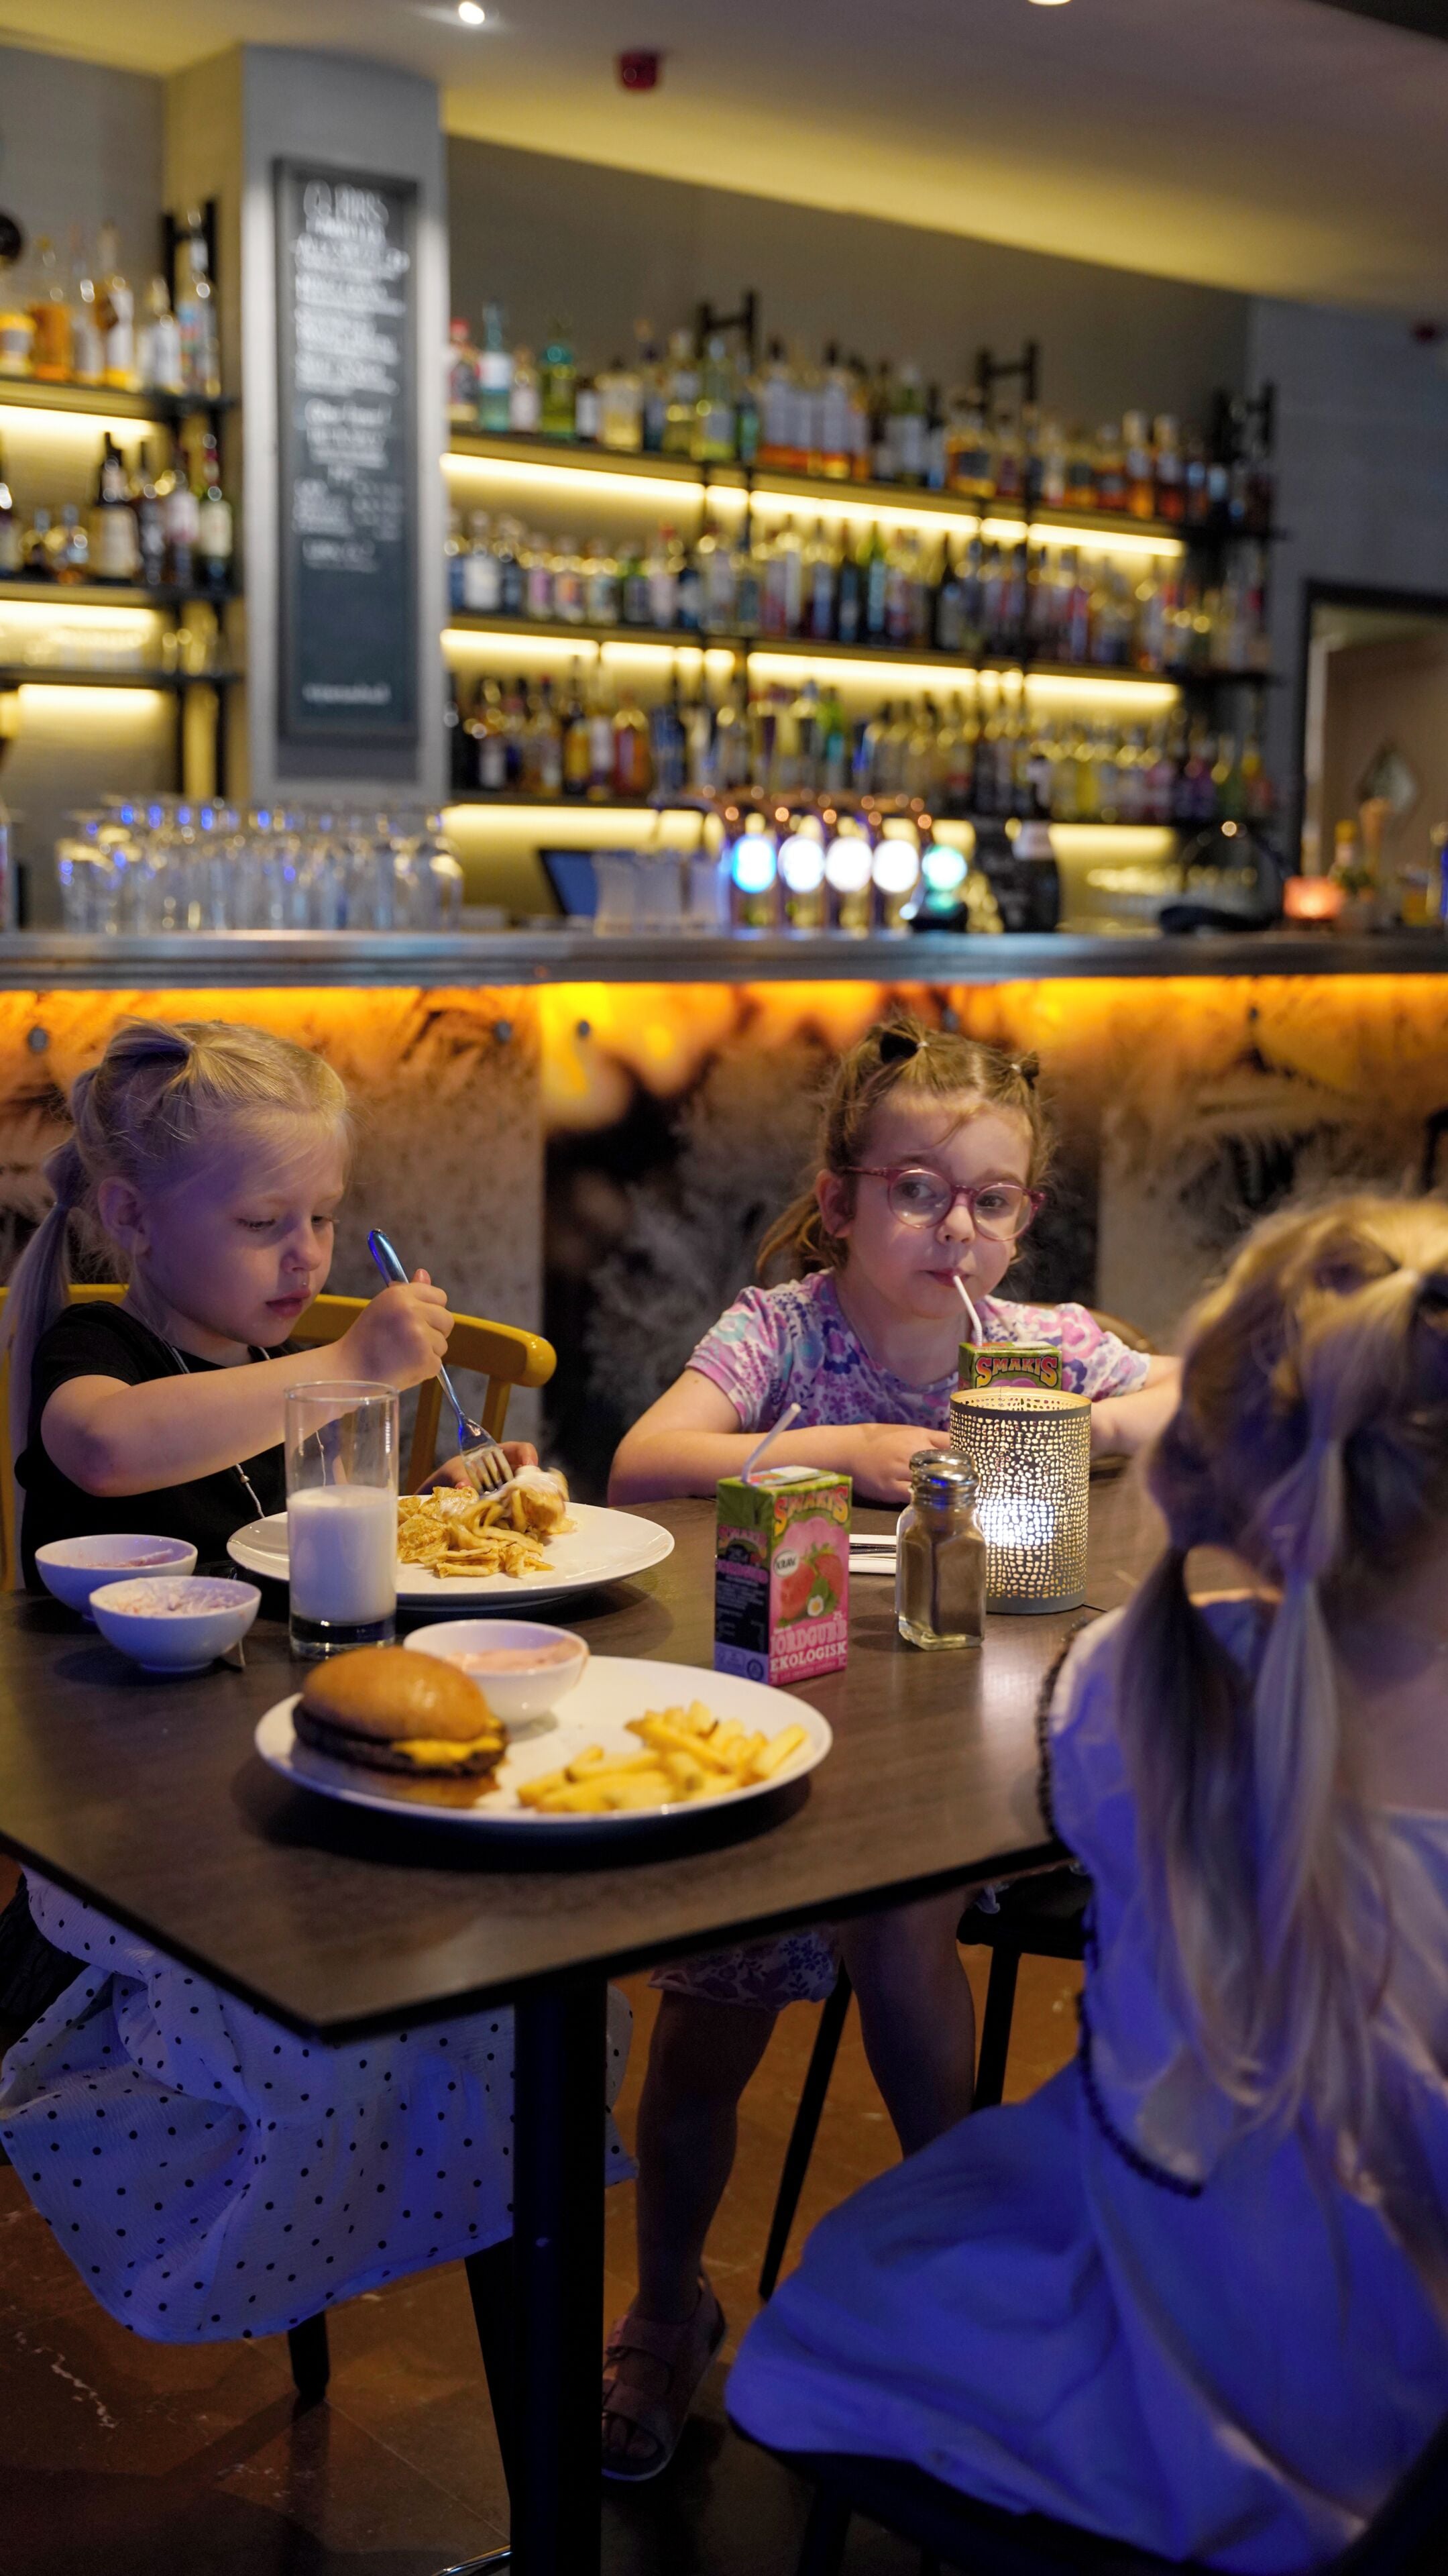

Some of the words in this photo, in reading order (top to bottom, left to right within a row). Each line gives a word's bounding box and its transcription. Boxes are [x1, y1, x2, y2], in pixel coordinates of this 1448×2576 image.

[976, 1356, 1058, 1388] SMAKIS
[773, 1485, 848, 1536] SMAKIS
[769, 1619, 847, 1658] JORDGUBB
[770, 1641, 846, 1672] EKOLOGISK
